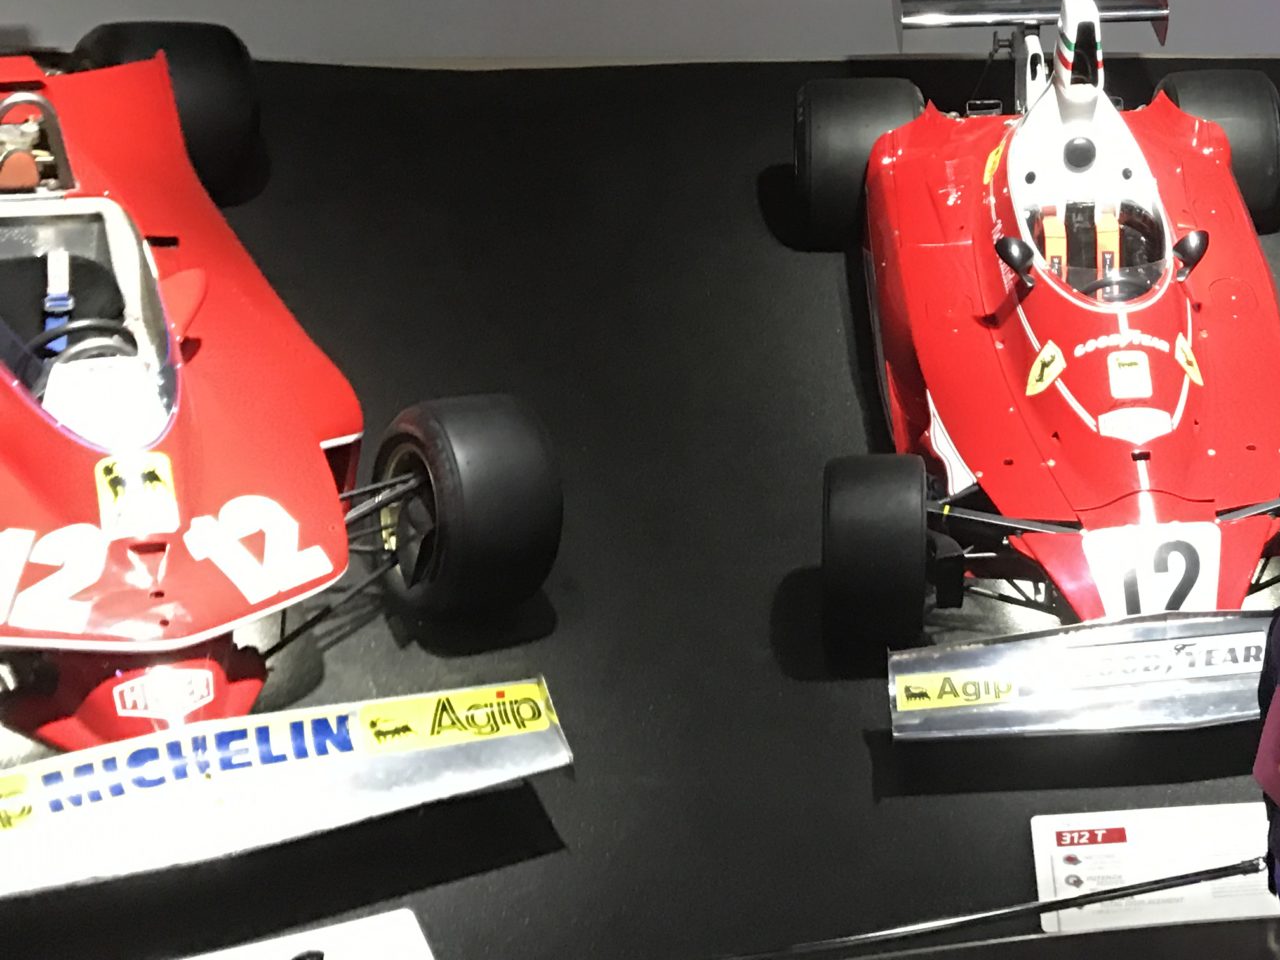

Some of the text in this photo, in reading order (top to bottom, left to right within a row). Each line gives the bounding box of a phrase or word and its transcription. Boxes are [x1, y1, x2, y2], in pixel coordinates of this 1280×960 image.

[1121, 539, 1201, 616] 12
[41, 714, 354, 813] MICHELIN
[429, 690, 542, 736] Agip
[1060, 829, 1107, 845] 312 T
